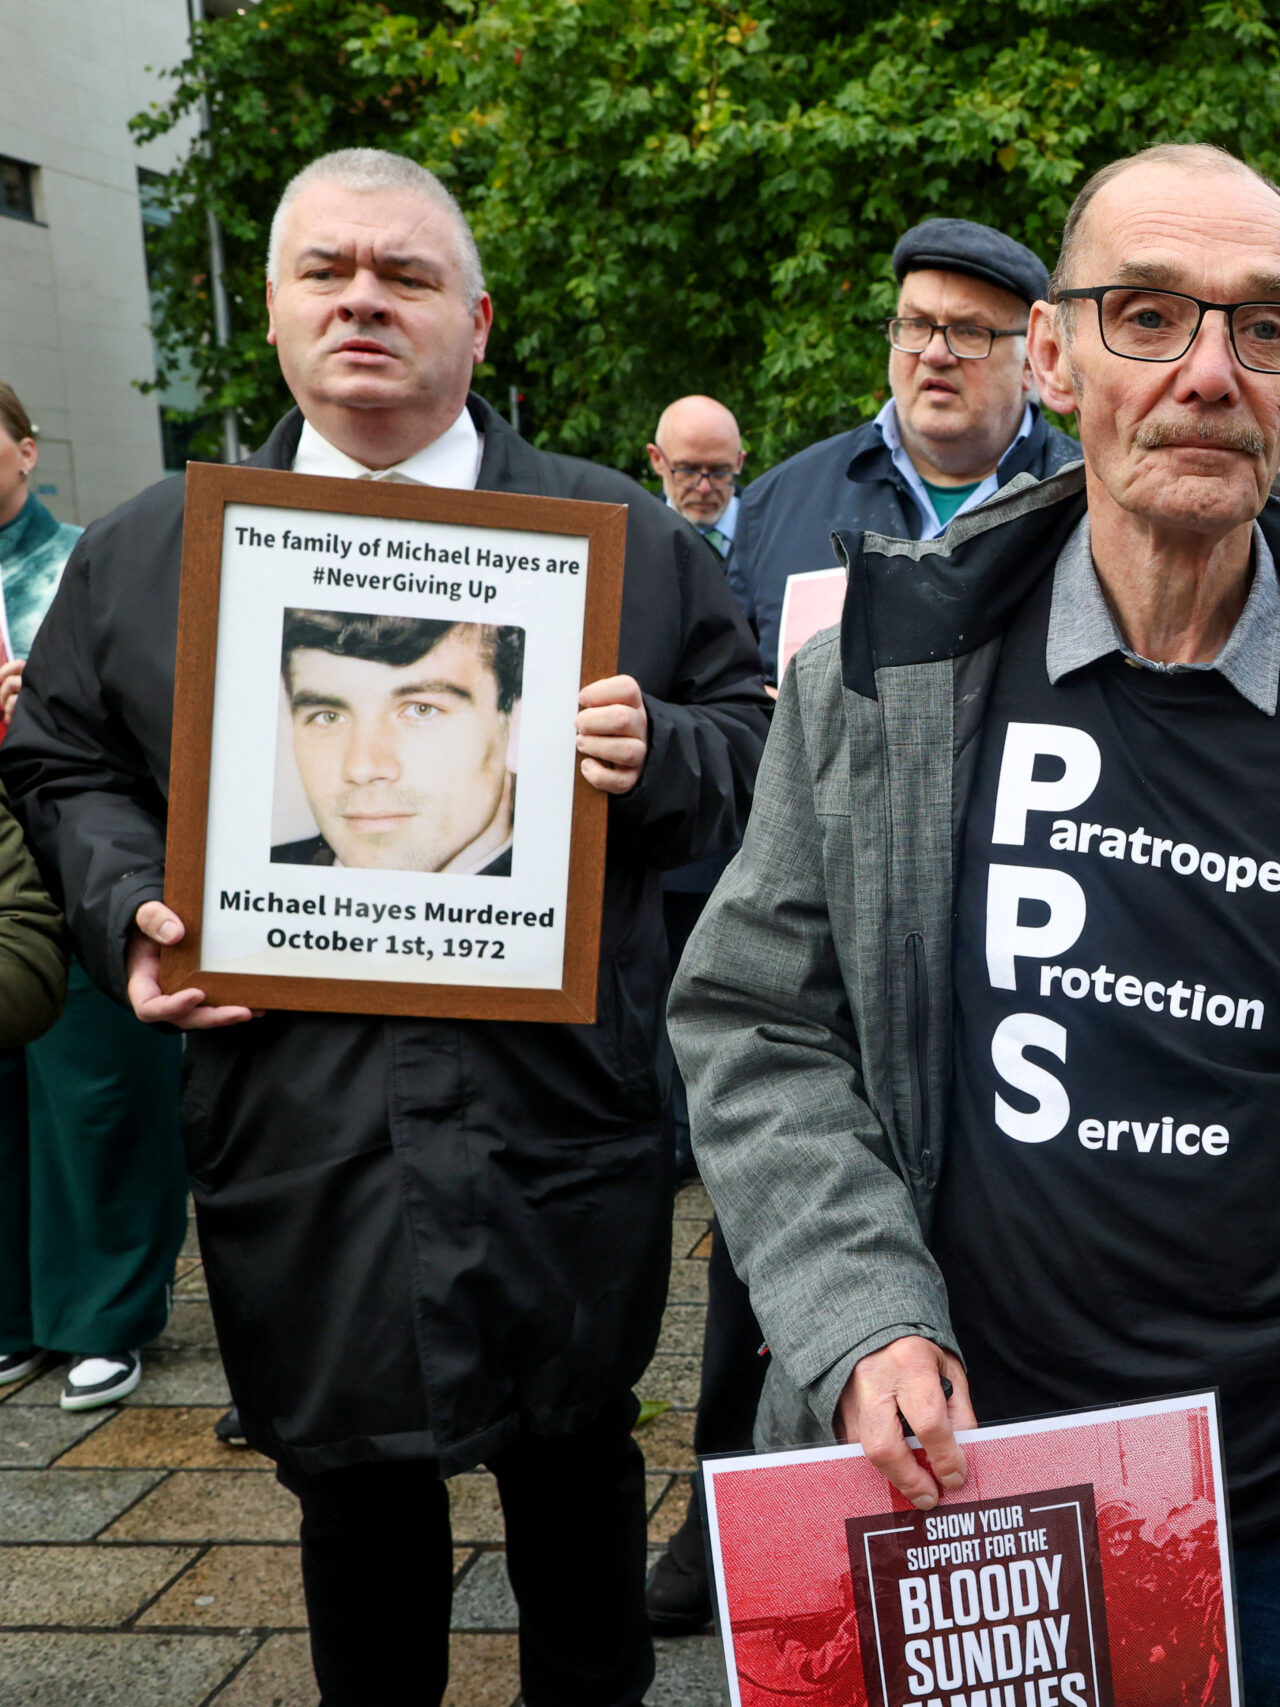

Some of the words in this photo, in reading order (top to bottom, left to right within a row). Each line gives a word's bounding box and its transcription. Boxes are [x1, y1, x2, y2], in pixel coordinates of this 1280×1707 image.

[235, 527, 275, 549] The
[282, 531, 353, 558] family
[359, 538, 383, 557] of
[387, 540, 470, 566] Michael
[477, 549, 540, 574] Hayes
[546, 558, 580, 575] are
[313, 567, 462, 601] #NeverGiving
[468, 580, 497, 603] Up
[220, 890, 326, 916] Michael
[334, 897, 417, 924] Hayes
[424, 902, 555, 928] Murdered
[267, 928, 378, 953] October
[385, 934, 434, 961] 1st,
[442, 938, 506, 960] 1972
[926, 1516, 975, 1541] SHOW
[979, 1505, 1023, 1535] YOUR
[907, 1538, 981, 1571] SUPPORT
[985, 1533, 1016, 1559] FOR
[1018, 1528, 1048, 1555] THE
[899, 1554, 1063, 1636] BLOODY
[904, 1614, 1070, 1696] SUNDAY
